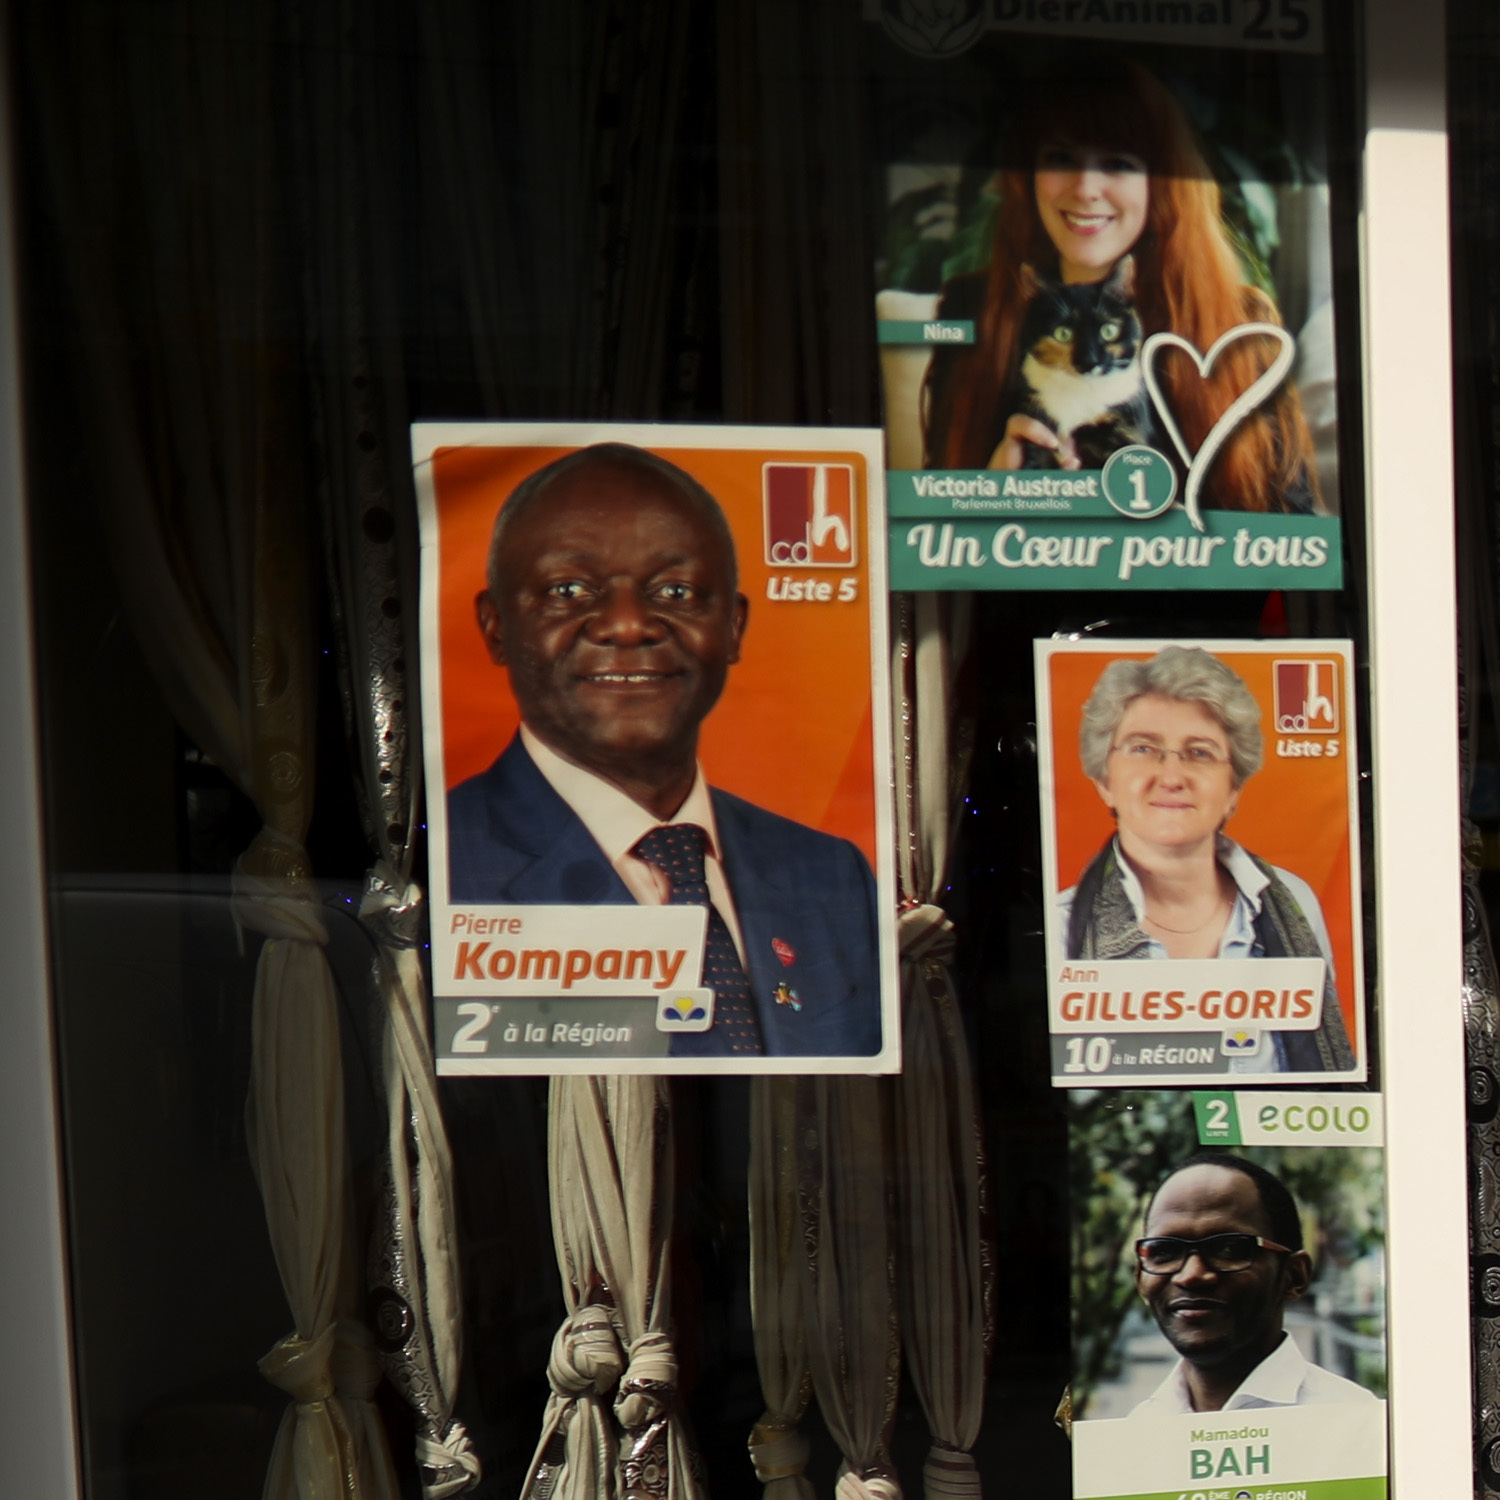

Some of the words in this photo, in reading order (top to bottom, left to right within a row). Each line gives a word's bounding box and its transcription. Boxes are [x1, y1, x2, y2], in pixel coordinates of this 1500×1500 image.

[1243, 0, 1308, 41] 25
[922, 323, 965, 342] Nina
[911, 475, 999, 498] Victoria
[1002, 476, 1098, 499] Austraet
[1128, 469, 1152, 510] 1
[907, 523, 987, 568] Un
[991, 522, 1113, 569] Cœur
[1117, 535, 1226, 581] pour
[1233, 528, 1328, 568] tous
[766, 576, 833, 601] Liste
[838, 577, 858, 602] 5
[1276, 738, 1323, 757] Liste
[1324, 739, 1340, 758] 5
[450, 912, 523, 935] Pierre
[453, 940, 687, 990] Kompany
[1059, 966, 1099, 983] Ann
[1060, 989, 1315, 1022] GILLES-GORIS
[503, 1022, 519, 1042] à
[524, 1022, 547, 1043] la
[551, 1022, 632, 1047] Région
[1139, 1044, 1215, 1065] RÉGION
[1205, 1099, 1230, 1130] 2
[1259, 1105, 1370, 1132] ecolo
[1191, 1426, 1270, 1443] Mamadou
[1190, 1444, 1270, 1480] BAH
